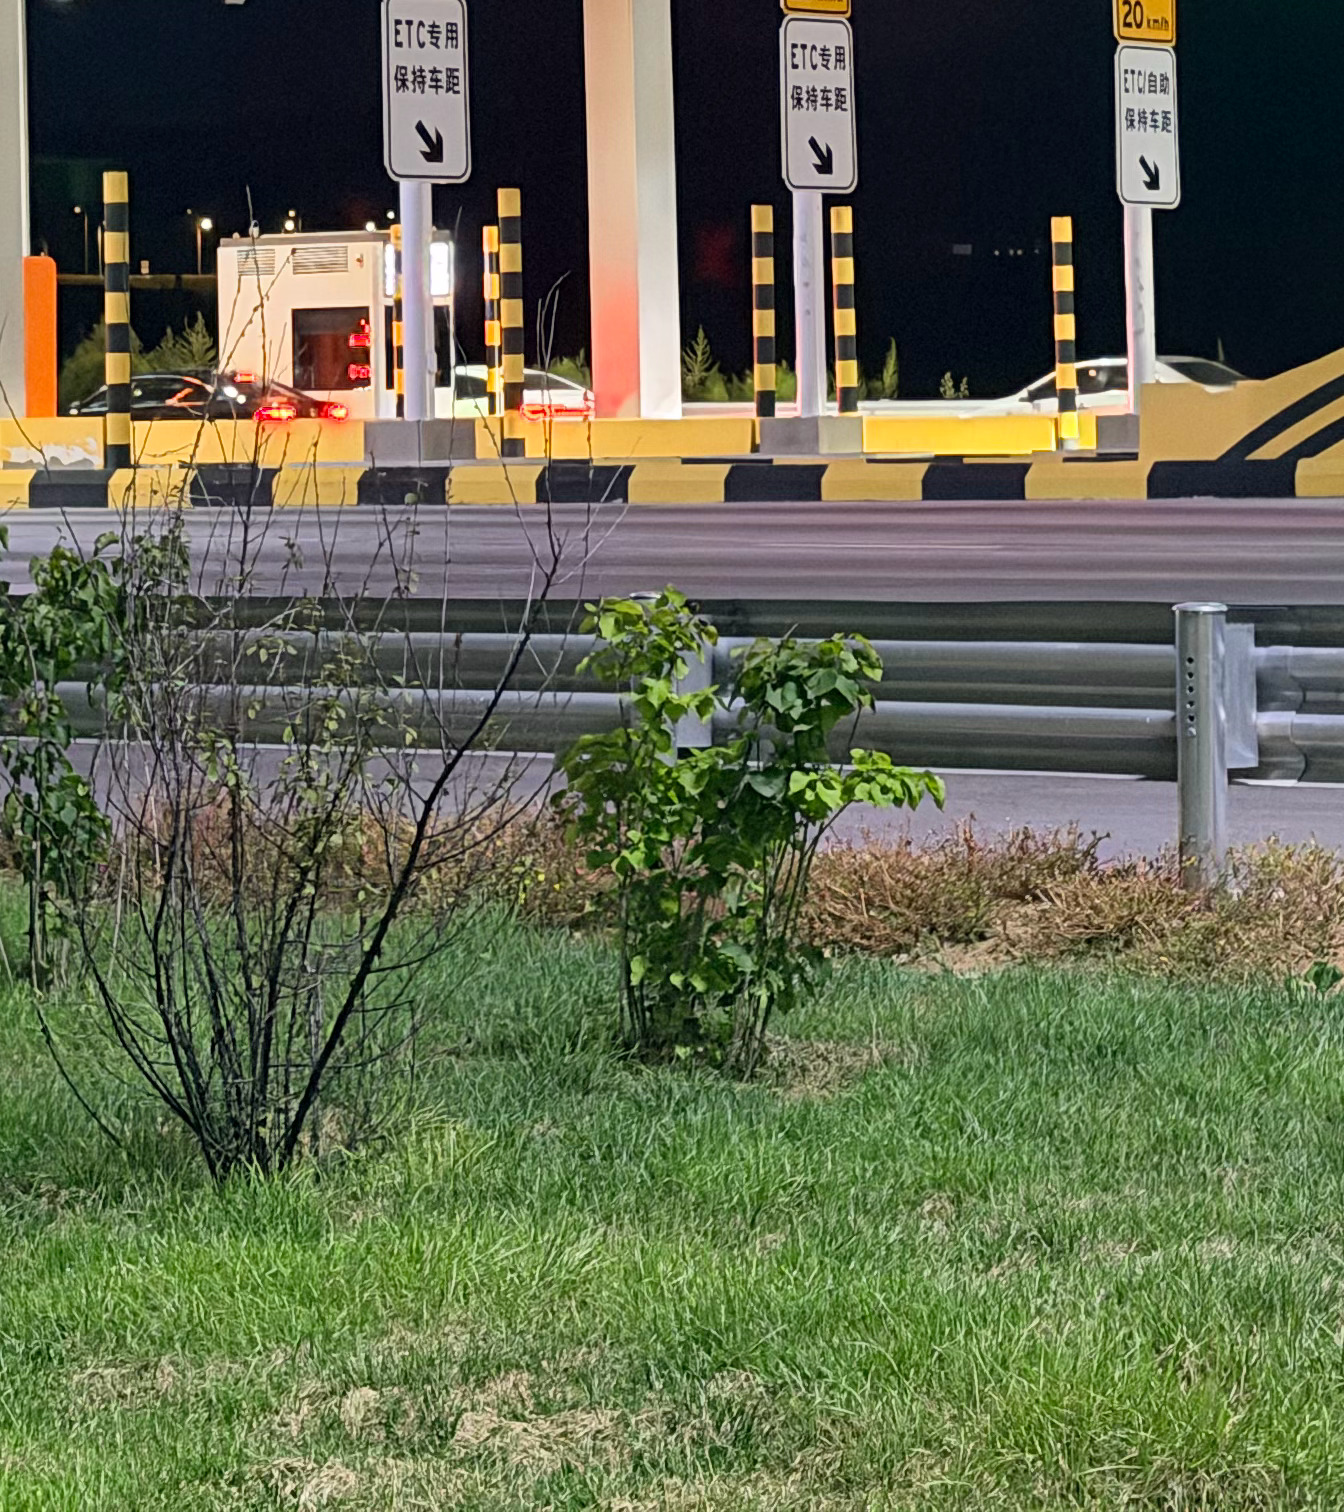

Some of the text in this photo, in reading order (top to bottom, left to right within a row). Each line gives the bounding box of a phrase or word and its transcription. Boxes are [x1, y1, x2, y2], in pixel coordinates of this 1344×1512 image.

[1122, 0, 1144, 29] 20
[394, 18, 459, 51] ETC专用
[791, 43, 846, 72] ETC专用
[393, 64, 461, 95] 保持车距
[1124, 68, 1169, 96] ETC/自助
[790, 84, 848, 114] 保持车距
[1125, 108, 1172, 134] 保持车距
